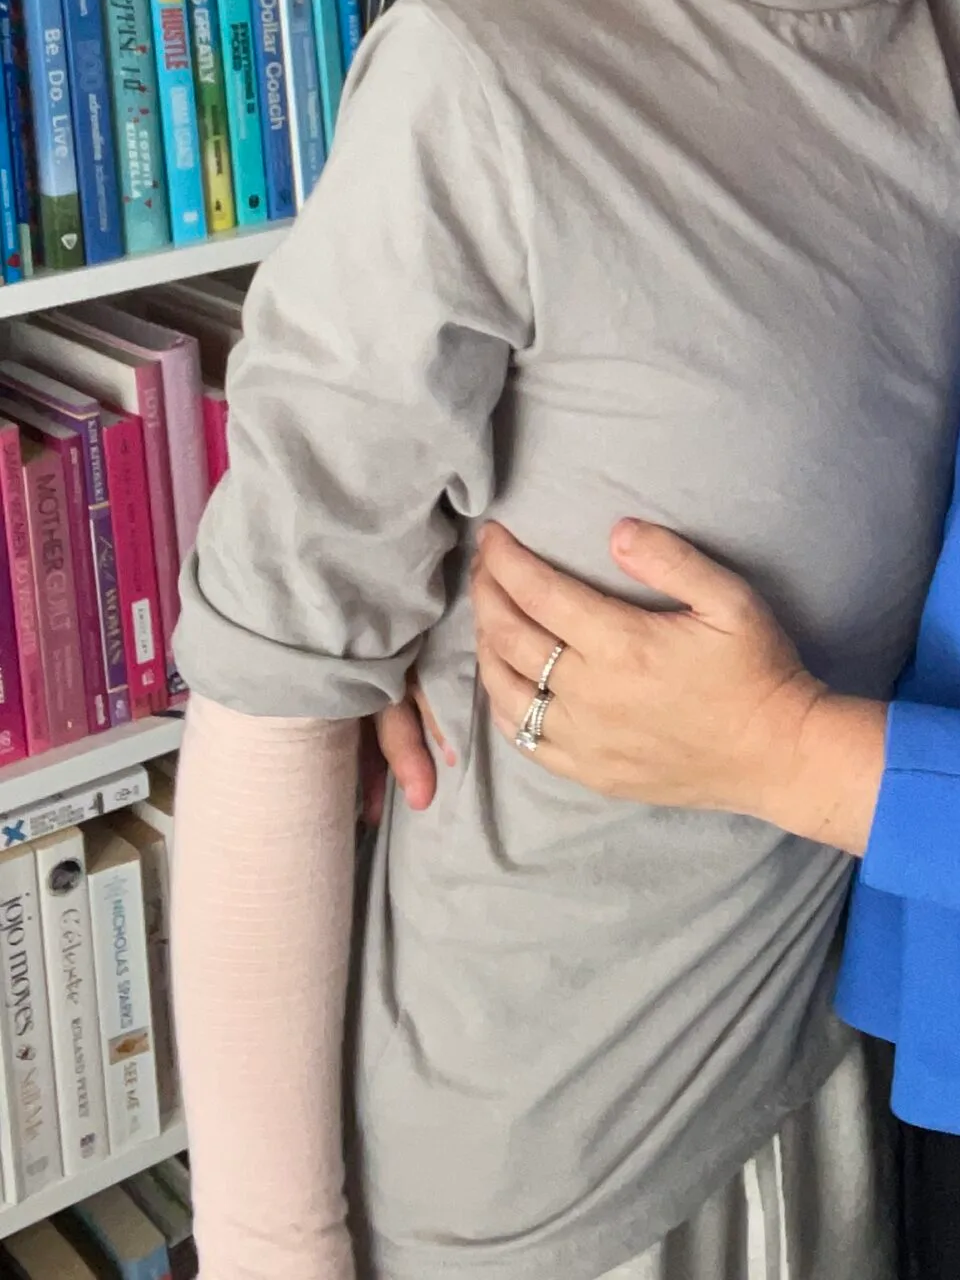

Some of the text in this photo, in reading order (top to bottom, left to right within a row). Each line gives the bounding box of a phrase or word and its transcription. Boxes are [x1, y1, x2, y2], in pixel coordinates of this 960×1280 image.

[161, 7, 189, 70] HUSTLE
[193, 7, 216, 84] GREATLY
[45, 28, 69, 164] Be. Do. Live.
[265, 62, 285, 130] Coach
[1, 893, 35, 1036] jojo moyes
[112, 899, 133, 1029] NICHOLAS SPARKS
[124, 1061, 139, 1087] SEE
